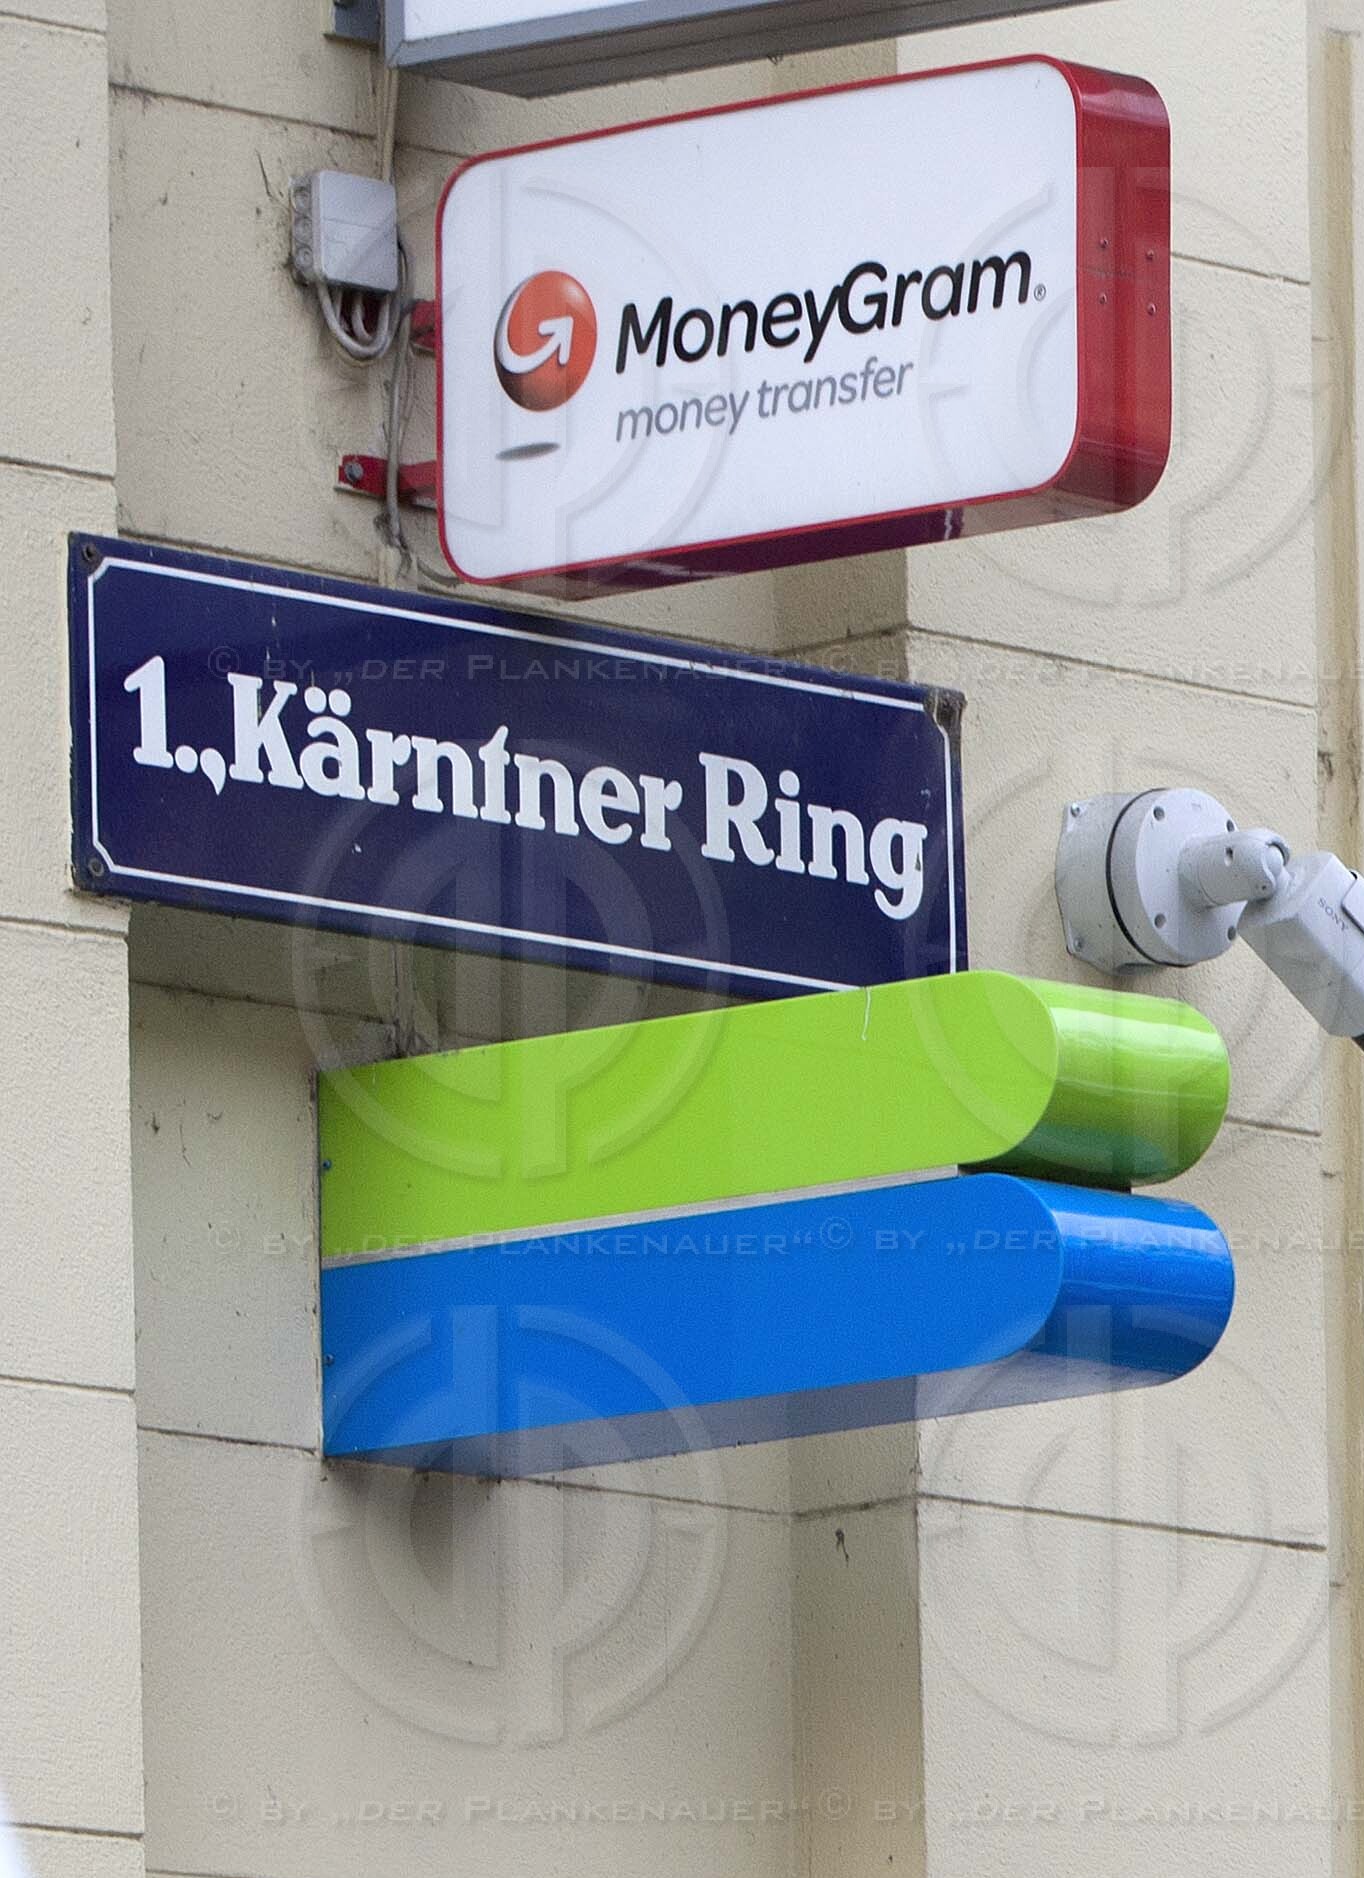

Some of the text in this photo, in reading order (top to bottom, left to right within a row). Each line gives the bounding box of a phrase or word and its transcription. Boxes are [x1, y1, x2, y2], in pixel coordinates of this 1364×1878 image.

[616, 356, 914, 442] money transfer
[700, 751, 928, 921] Ring
[1317, 896, 1349, 932] SONY
